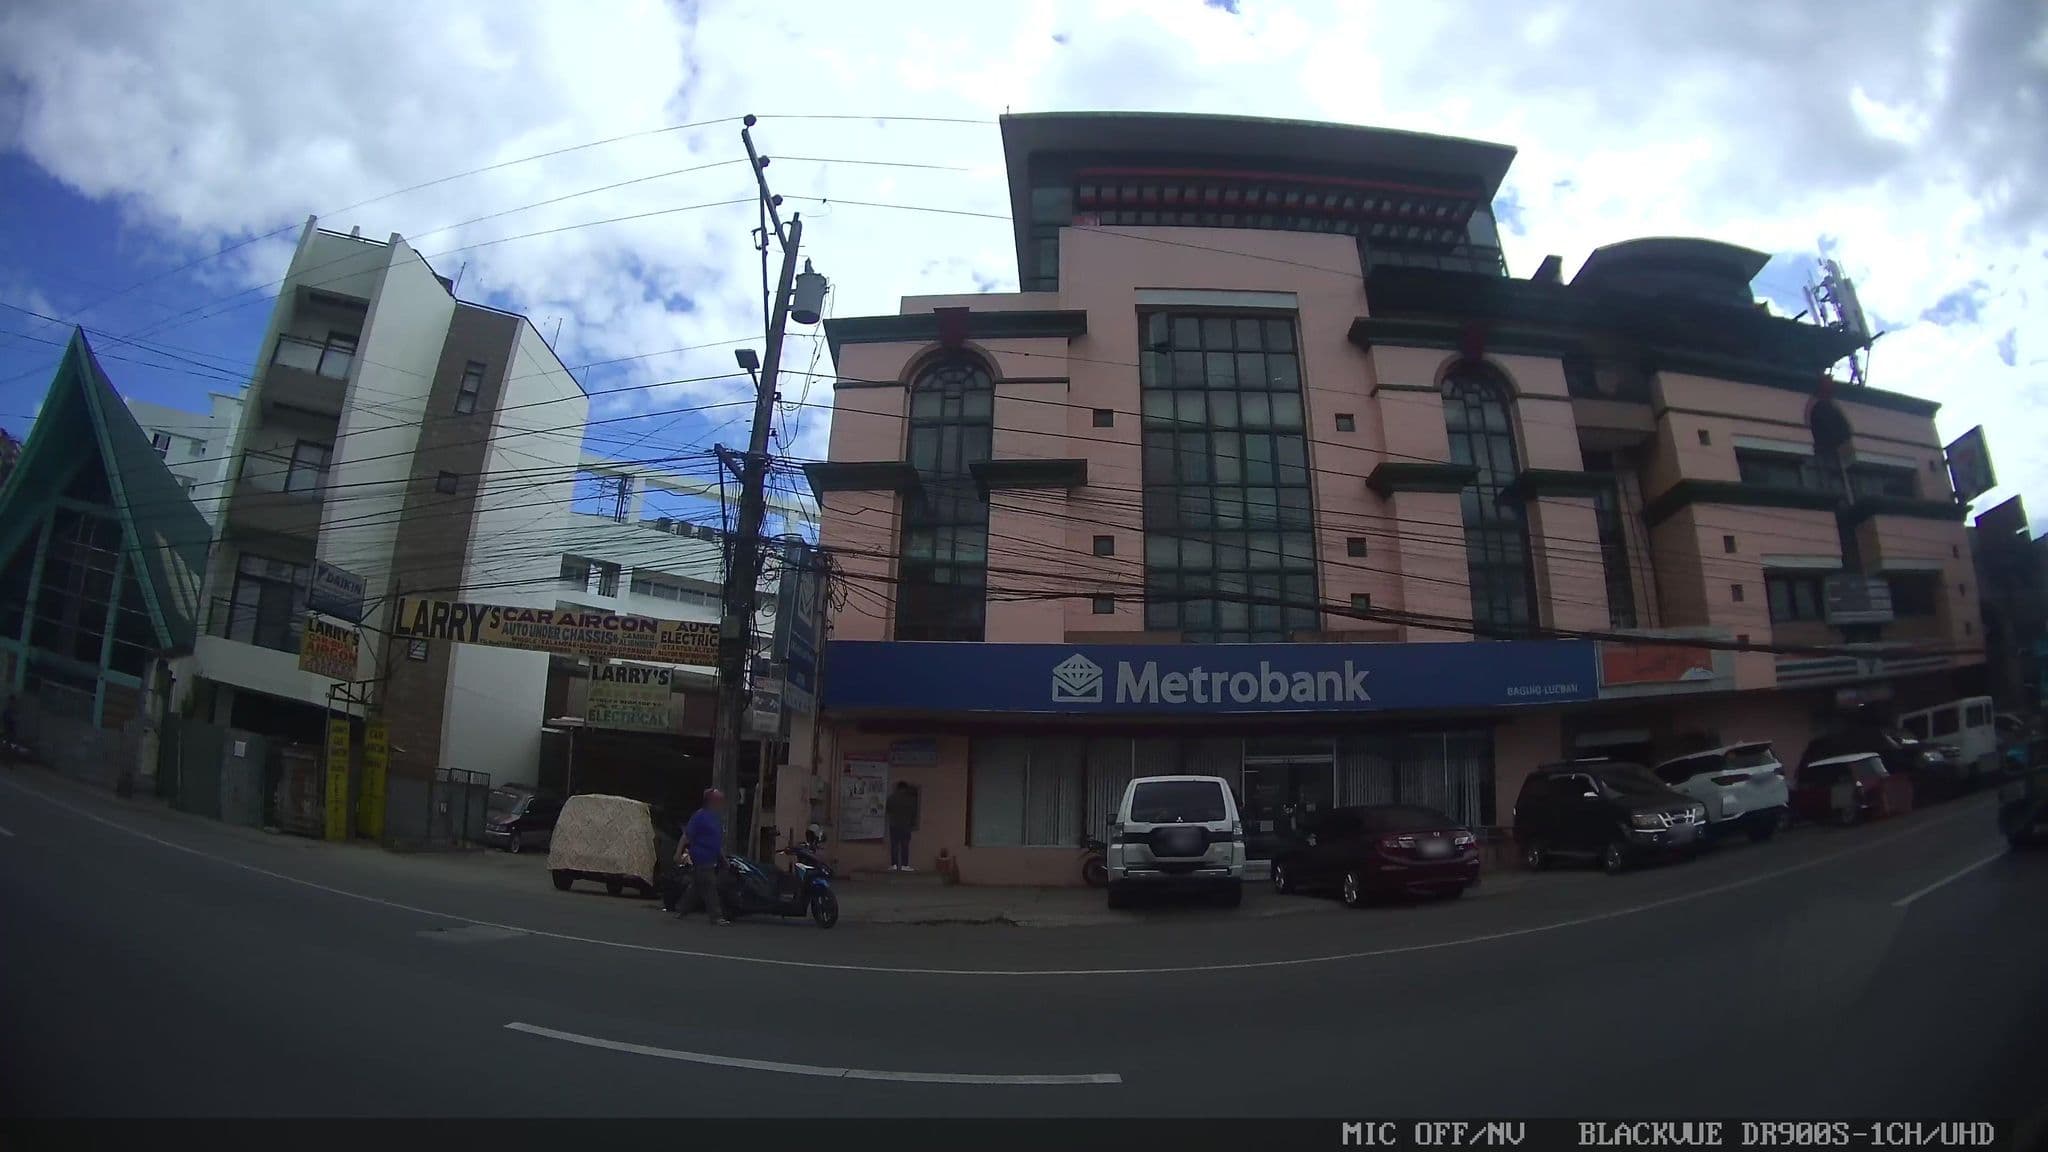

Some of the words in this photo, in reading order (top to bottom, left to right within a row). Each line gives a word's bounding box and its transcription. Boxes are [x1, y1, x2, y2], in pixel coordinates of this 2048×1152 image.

[327, 572, 363, 594] DAIKIN
[398, 598, 500, 642] LARRY'S
[503, 606, 554, 625] CAR
[556, 612, 659, 633] AIRCON
[677, 621, 719, 634] AUTO
[308, 618, 360, 647] LARRY'S
[502, 622, 528, 637] AUTO
[529, 625, 561, 639] UNDER
[561, 627, 613, 643] CHASSIS
[591, 664, 670, 686] LARRY'S
[1115, 660, 1372, 704] Metrobank
